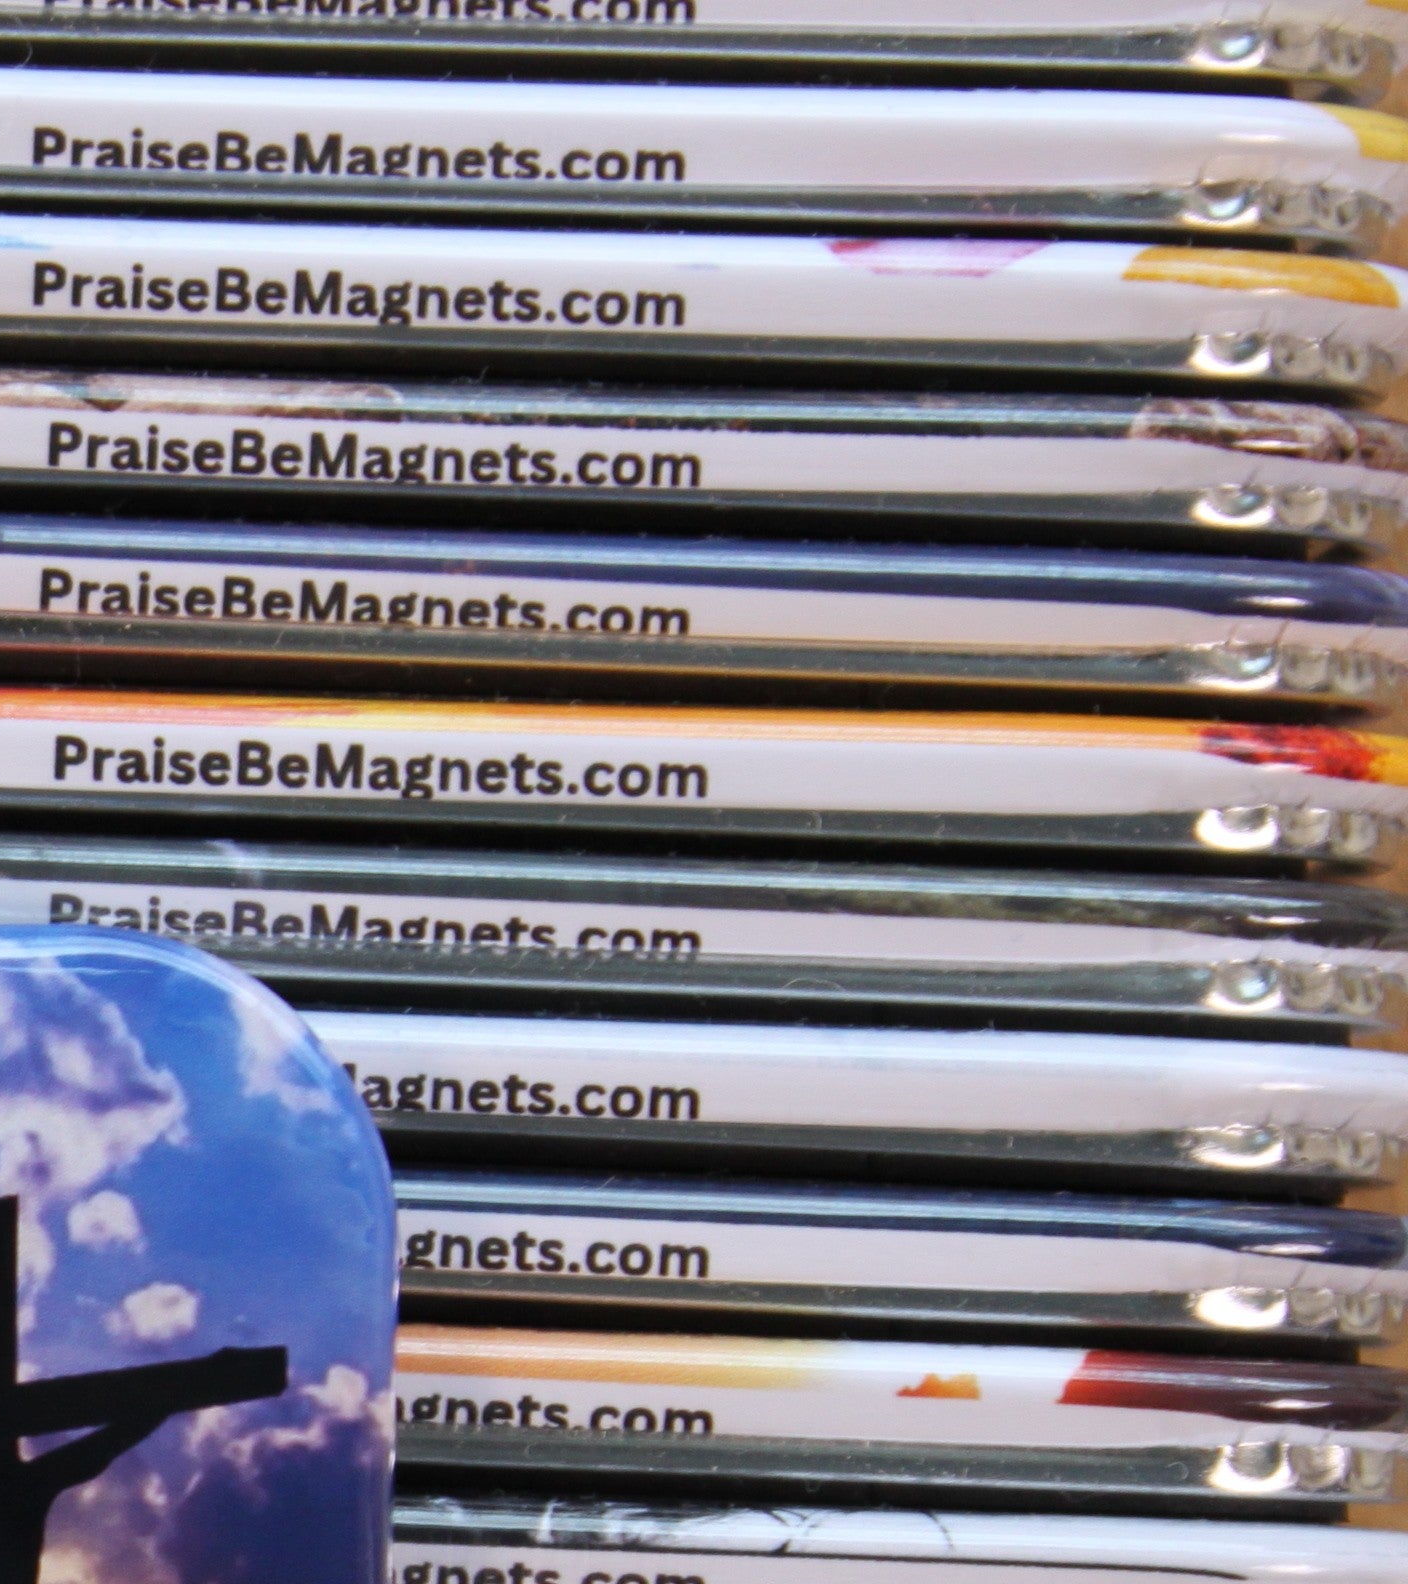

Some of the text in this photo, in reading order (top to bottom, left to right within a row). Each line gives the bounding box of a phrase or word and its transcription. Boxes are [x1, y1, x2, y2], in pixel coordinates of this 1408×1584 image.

[32, 127, 686, 181] PraiseBeMagnets.com
[32, 262, 686, 326] PraiseBeMagnets.com
[46, 422, 702, 487] PraiseBeMagnets.com
[38, 568, 690, 635] PraiseBeMagnets.com
[54, 735, 709, 800] PraiseBeMagnets.com
[49, 893, 702, 960] PraiseBeMagnetscom
[344, 1064, 700, 1120] agnets.com
